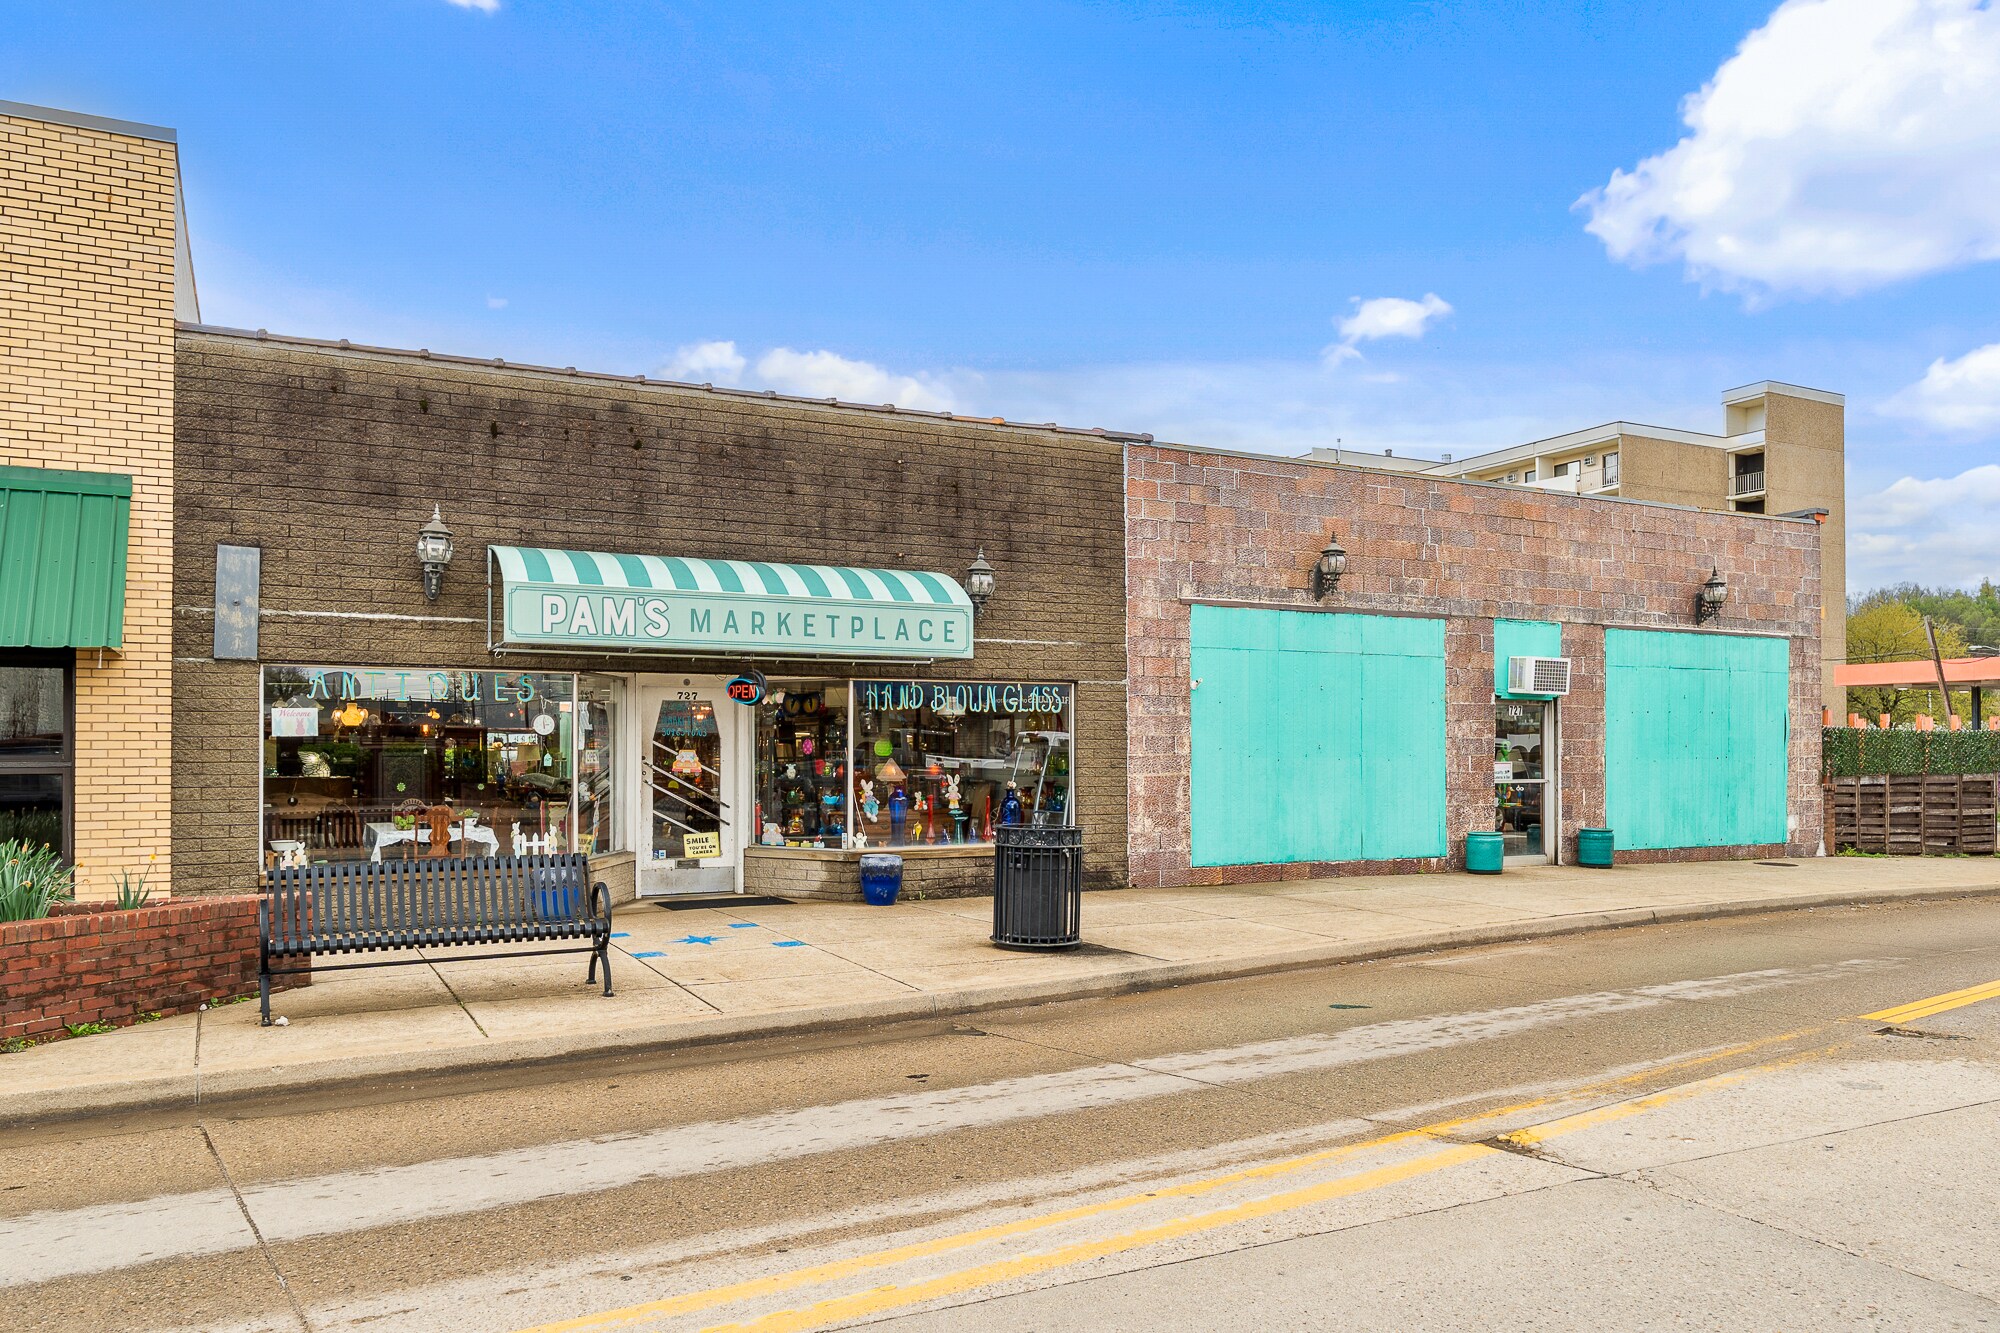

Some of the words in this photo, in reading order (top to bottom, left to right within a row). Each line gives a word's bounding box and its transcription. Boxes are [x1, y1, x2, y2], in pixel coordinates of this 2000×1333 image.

[541, 593, 671, 638] PAM'S
[690, 608, 955, 643] MARKETPLACE
[306, 671, 535, 702] ANTIQUES
[677, 692, 698, 700] 727
[727, 684, 756, 699] OPEN
[866, 684, 924, 711] HAND
[930, 685, 997, 712] BLOWN
[1003, 685, 1062, 713] GLASS
[1509, 705, 1522, 715] 727
